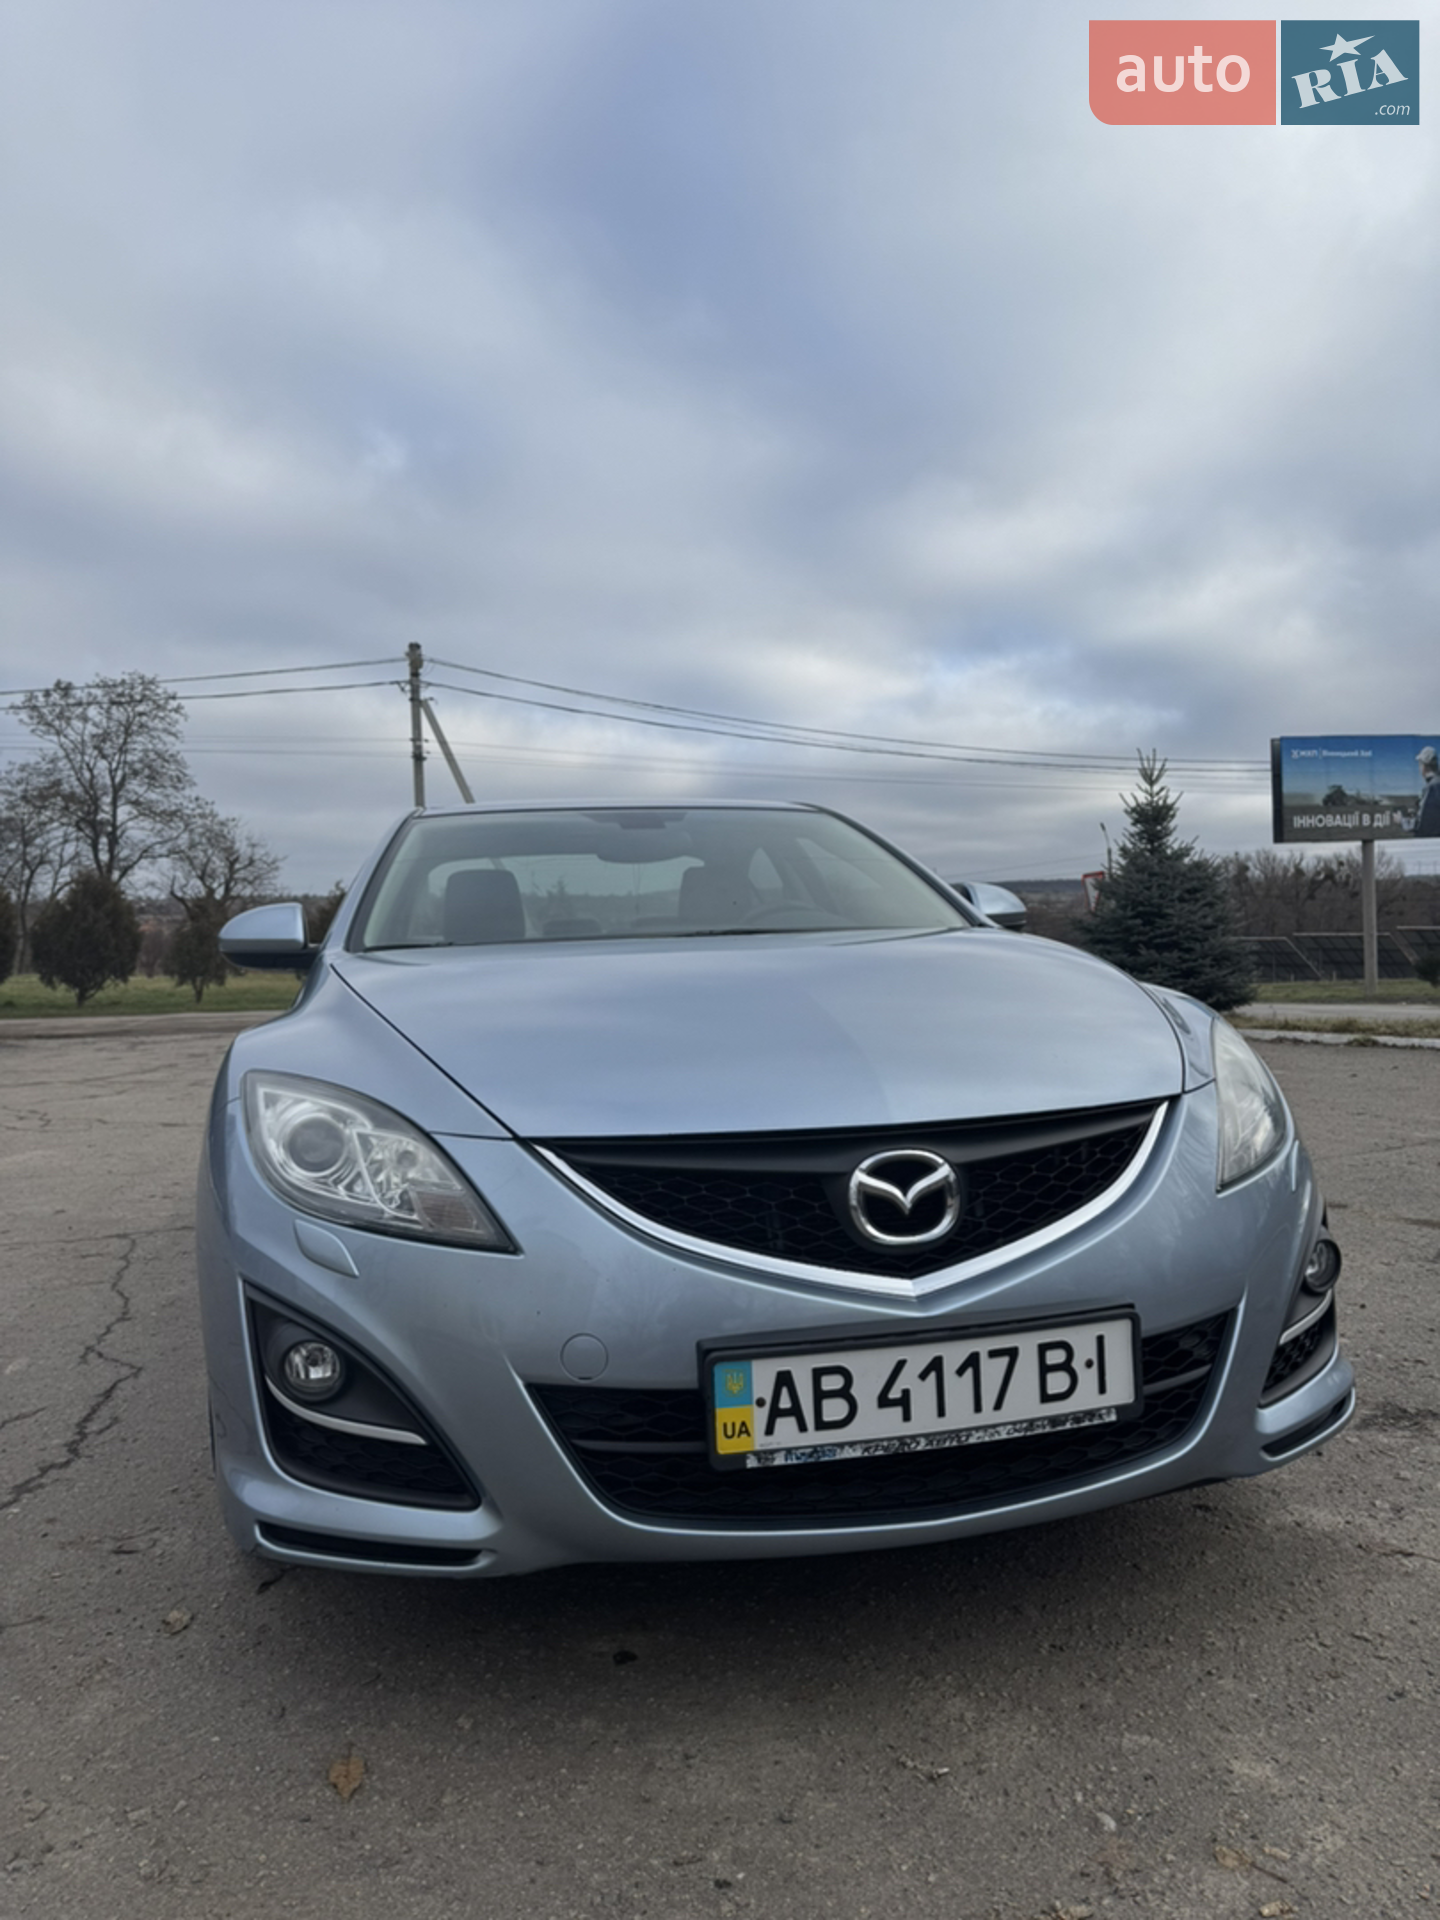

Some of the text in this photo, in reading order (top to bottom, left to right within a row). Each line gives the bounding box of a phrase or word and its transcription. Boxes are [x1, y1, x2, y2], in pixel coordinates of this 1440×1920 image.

[1293, 810, 1391, 828] ІННОВАЦІЇ В ДІЇ
[764, 1334, 1107, 1436] AB 4117 BI
[722, 1421, 751, 1439] UA
